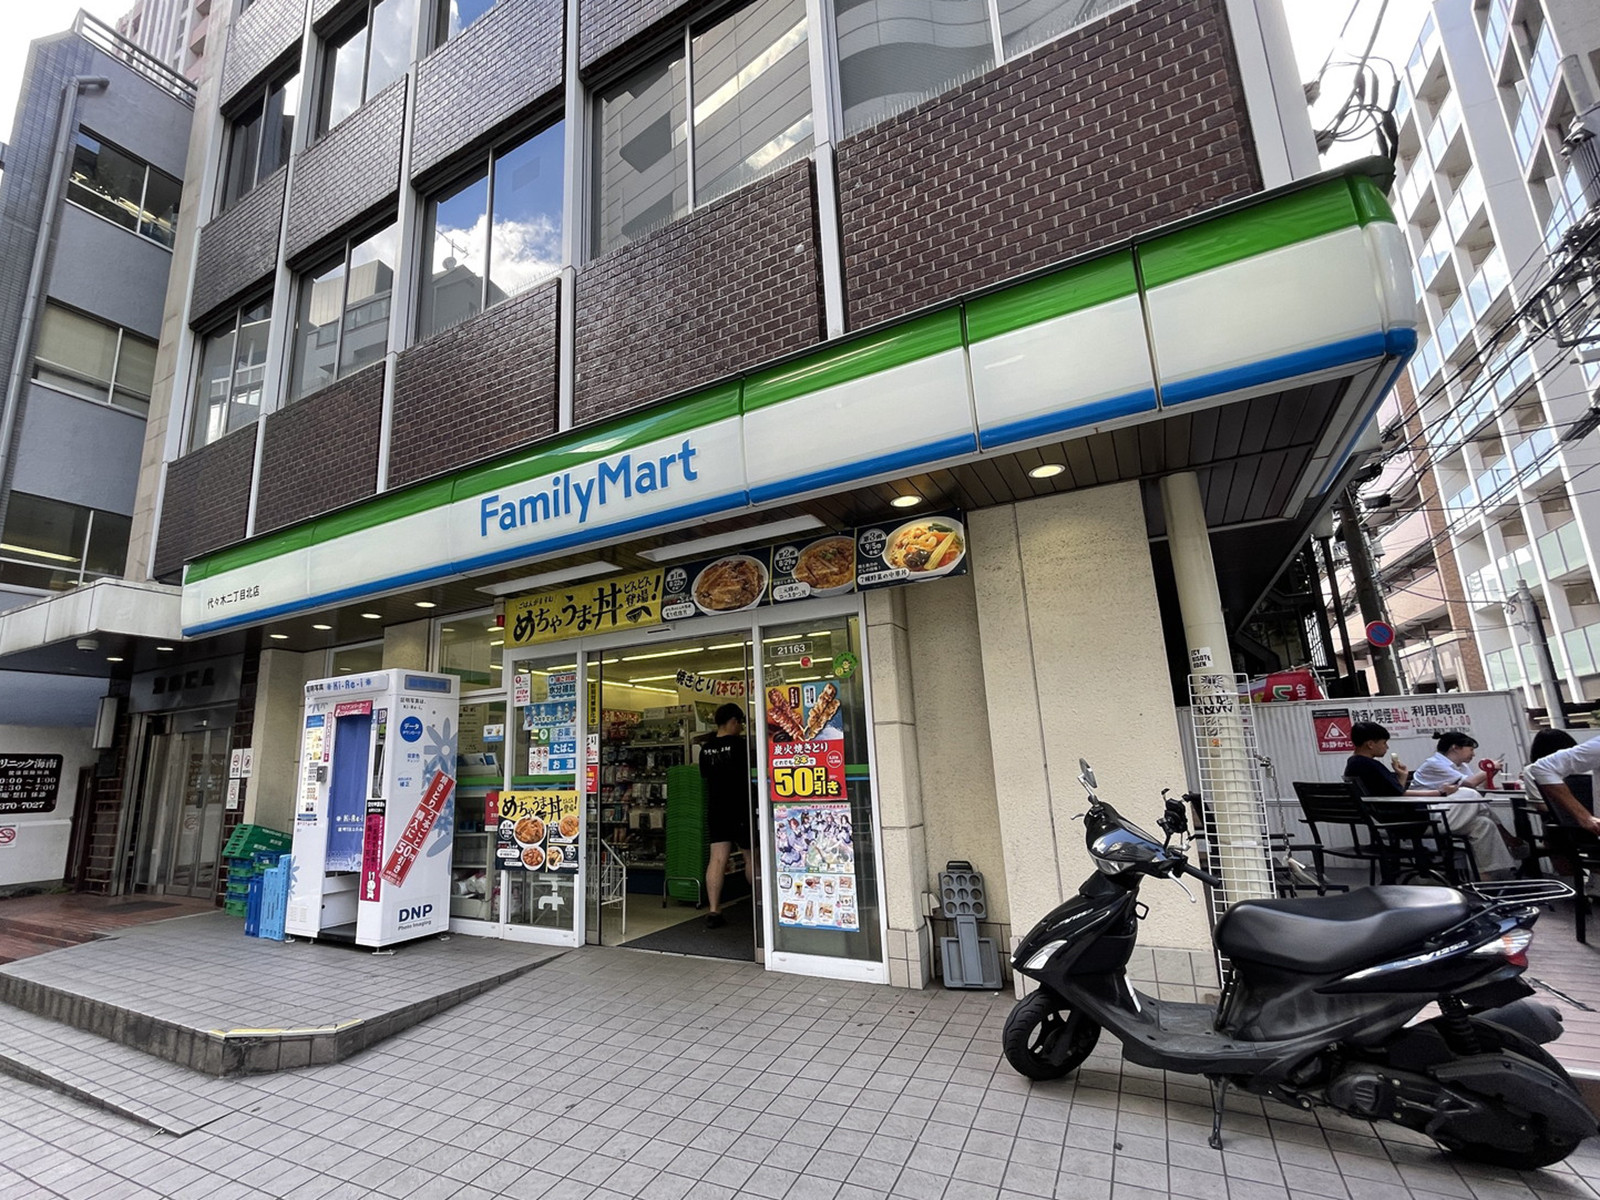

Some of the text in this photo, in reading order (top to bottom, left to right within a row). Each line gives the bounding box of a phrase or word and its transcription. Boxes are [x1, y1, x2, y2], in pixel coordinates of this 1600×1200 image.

[481, 439, 698, 537] FamilyMart
[624, 576, 652, 594] どんどん
[207, 585, 260, 609] 代々木二丁目北店
[513, 583, 623, 642] めちゃうま丼
[777, 644, 806, 655] 21163
[1411, 703, 1466, 717] 利用時間
[403, 723, 420, 731] データ
[553, 743, 575, 753] たばこ
[773, 742, 828, 756] 炭火焼きとり
[1321, 741, 1354, 749] お静かに
[773, 767, 840, 797] 50円引き
[502, 795, 563, 821] めちゃうま丼
[398, 904, 433, 923] DNP
[412, 920, 432, 928] Imaging
